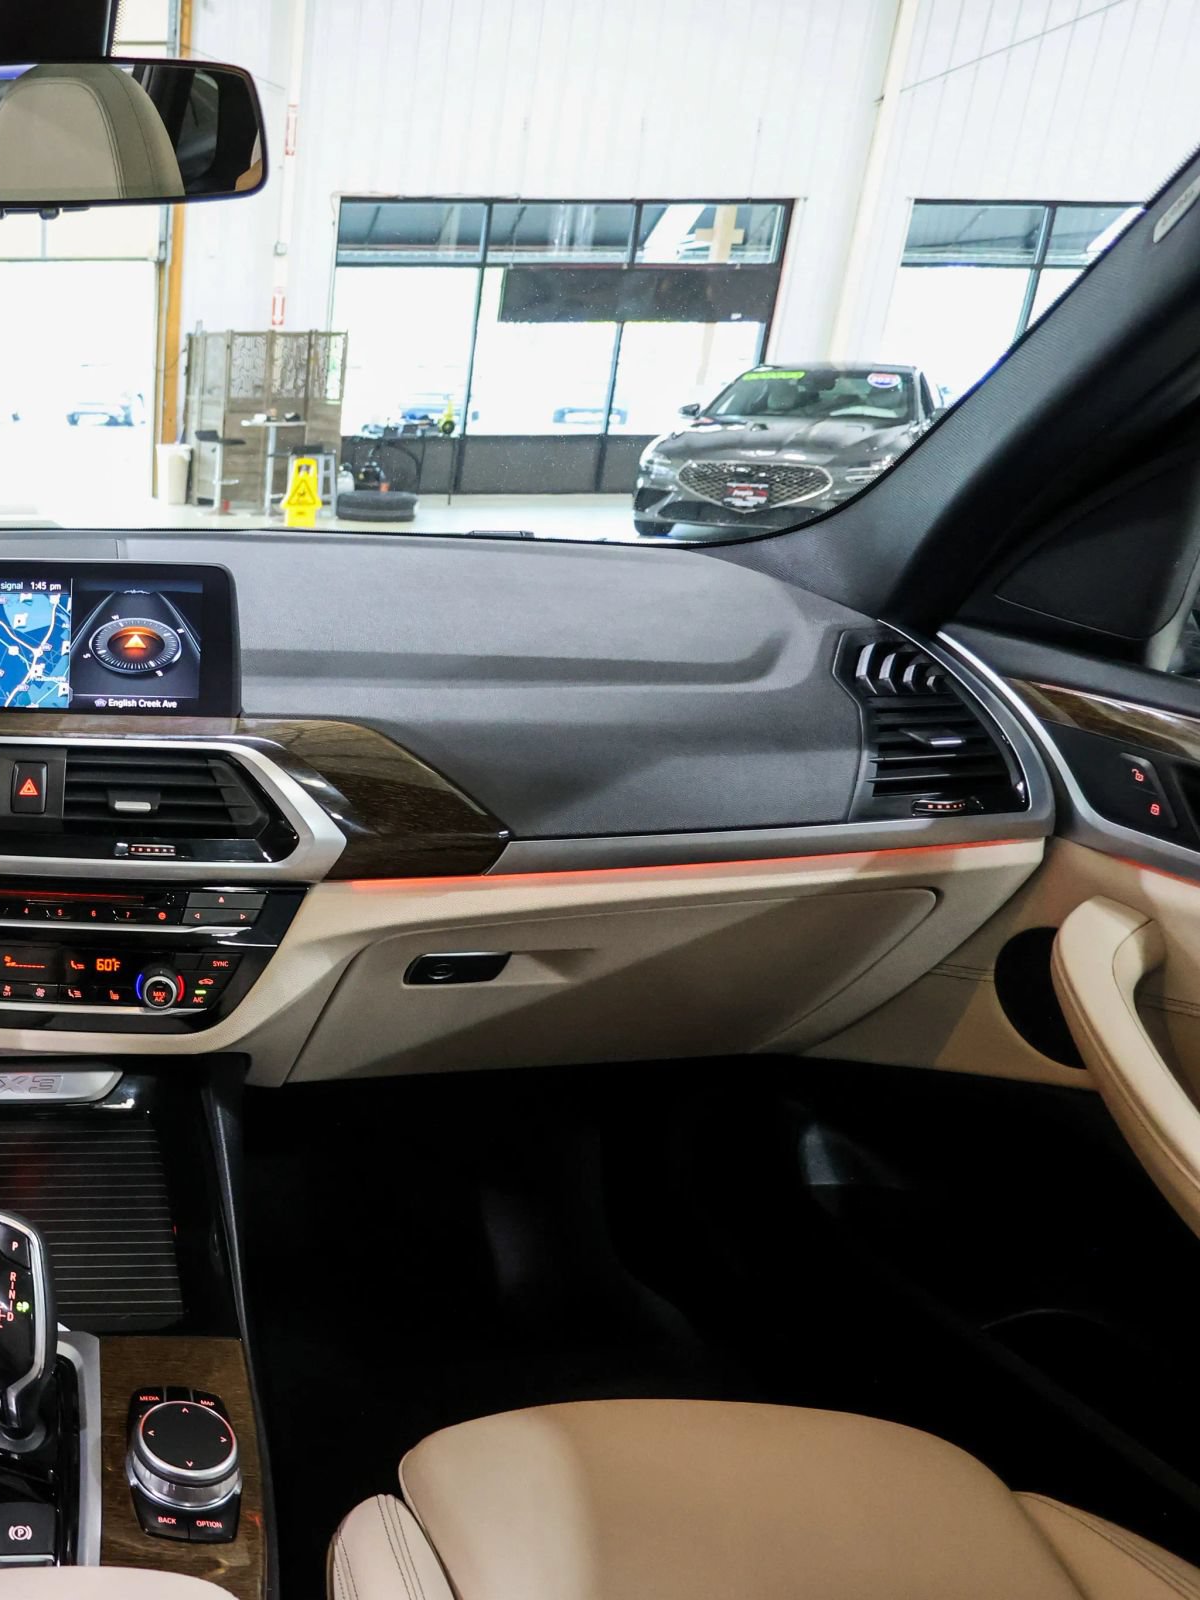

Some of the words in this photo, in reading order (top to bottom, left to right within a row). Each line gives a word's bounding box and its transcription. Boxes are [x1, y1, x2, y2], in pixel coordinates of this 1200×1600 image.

[0, 581, 24, 591] signal
[30, 581, 47, 590] 1:45
[108, 698, 138, 708] English
[138, 699, 161, 708] Creek
[162, 700, 178, 708] Ave
[95, 957, 121, 972] 60°F
[212, 960, 229, 968] SYNC
[192, 996, 204, 1004] A/C
[11, 1241, 19, 1251] P
[9, 1271, 17, 1282] R
[8, 1289, 16, 1299] N
[6, 1312, 14, 1322] D
[200, 1399, 215, 1407] MAP
[157, 1515, 177, 1525] BACK
[195, 1519, 223, 1529] OPTION
